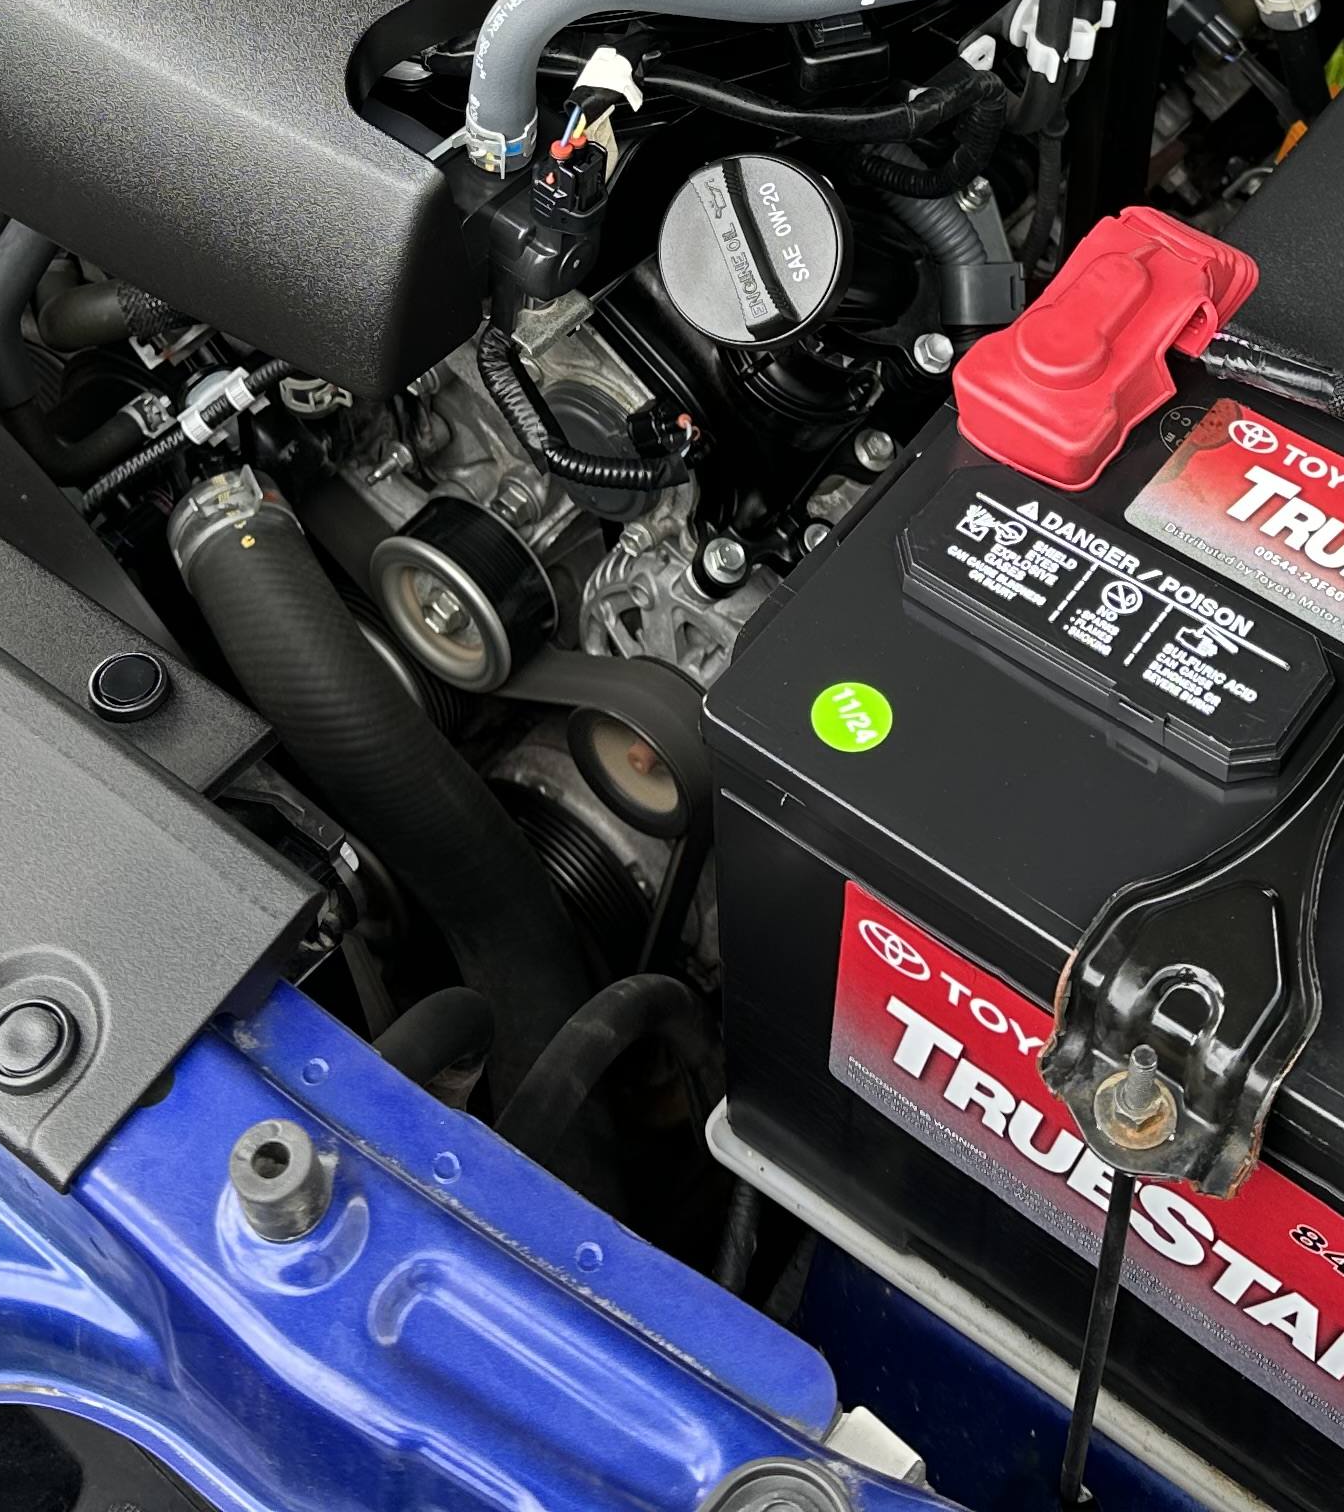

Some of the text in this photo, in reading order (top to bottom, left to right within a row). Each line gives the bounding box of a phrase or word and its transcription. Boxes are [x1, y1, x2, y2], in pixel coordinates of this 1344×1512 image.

[759, 182, 810, 282] SAE 0W-20
[721, 222, 768, 319] ENGINE OIL
[984, 552, 1026, 581] GASES
[990, 543, 1059, 587] EXPLOSIVE
[1025, 550, 1060, 573] EYES
[1032, 540, 1077, 571] SHIELD
[1040, 511, 1141, 575] DANGER
[1158, 576, 1254, 638] POISON
[1163, 521, 1236, 567] Distributed
[1236, 555, 1254, 576] by
[1254, 567, 1297, 600] Toyota
[1298, 595, 1340, 626] Motor
[1096, 605, 1118, 622] NO
[1156, 652, 1176, 670] CAN
[1162, 642, 1258, 704] SULFURIC ACID
[831, 686, 878, 745] 11/24
[939, 970, 1047, 1056] TOY
[848, 1055, 919, 1113] PROPOSITION
